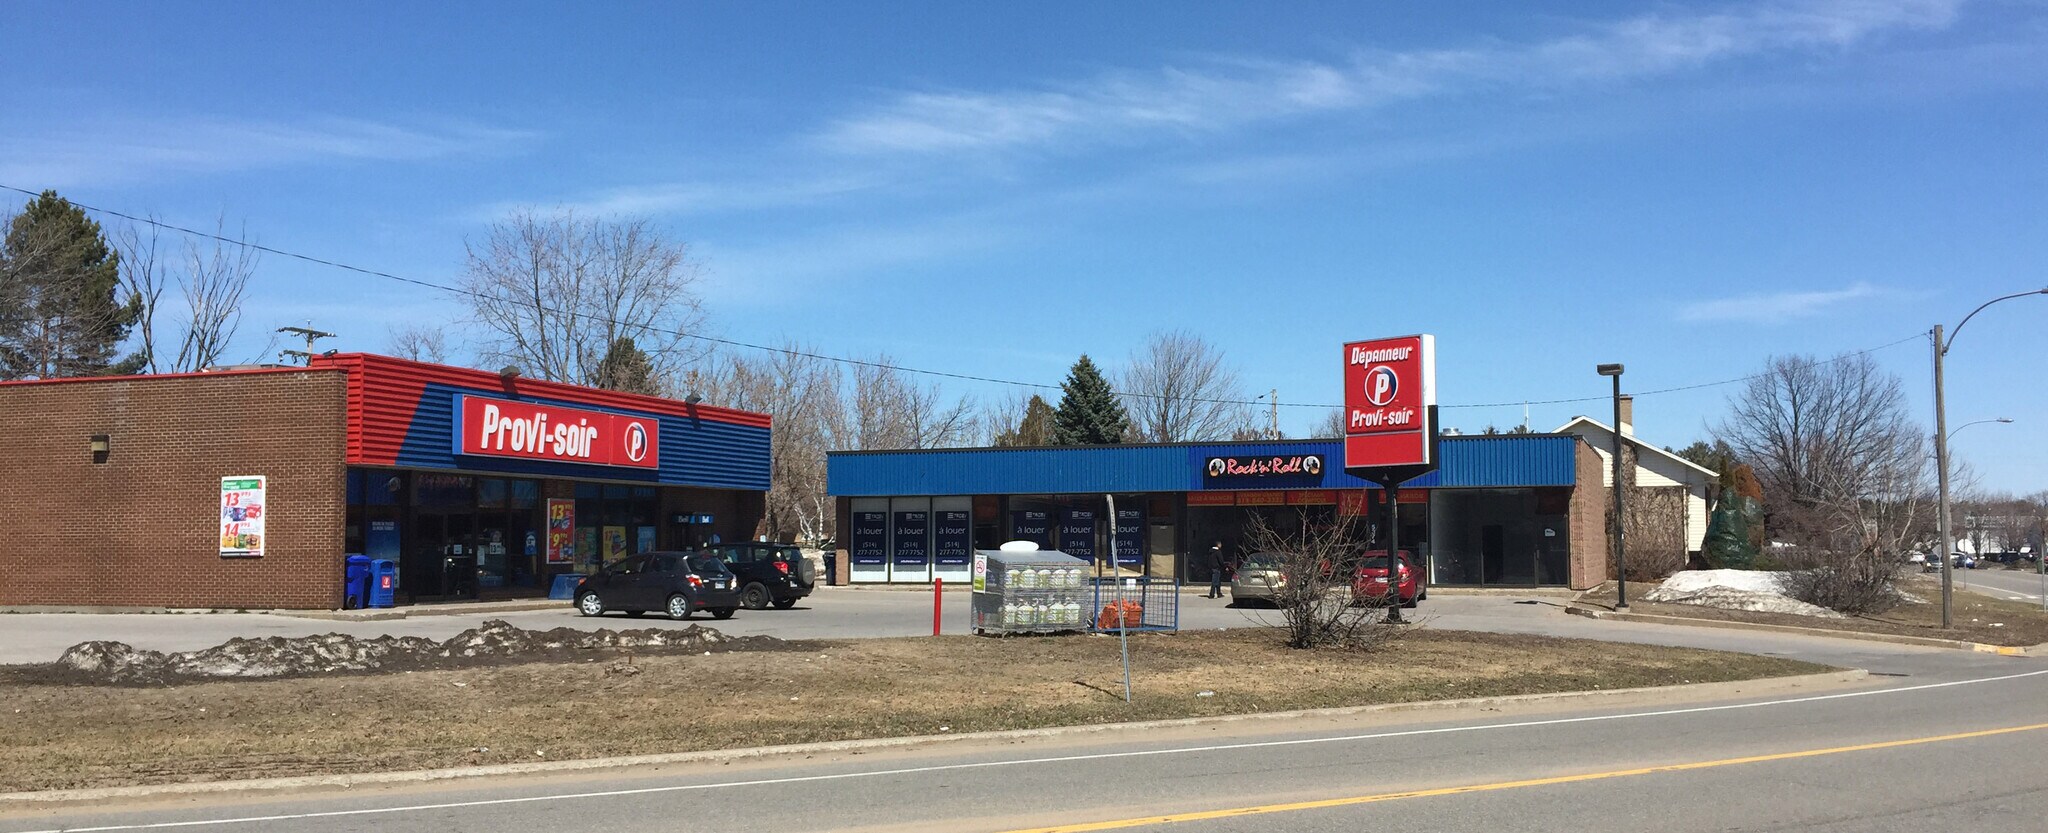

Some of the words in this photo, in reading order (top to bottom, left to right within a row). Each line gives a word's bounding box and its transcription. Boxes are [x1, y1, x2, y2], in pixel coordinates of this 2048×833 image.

[1351, 346, 1413, 369] Dépanneur
[1374, 373, 1390, 404] P
[1351, 407, 1414, 428] Provi-soir
[481, 404, 598, 458] Provi-soir
[631, 430, 642, 460] P
[224, 492, 240, 507] 13
[551, 504, 564, 520] 13
[224, 523, 240, 537] 14
[856, 527, 862, 535] à
[863, 527, 883, 535] louer
[897, 527, 903, 535] à
[904, 527, 924, 535] louer
[938, 526, 944, 534] à
[945, 526, 966, 534] louer
[1017, 526, 1023, 534] à
[1024, 526, 1045, 534] louer
[1063, 525, 1069, 534] à
[1070, 525, 1091, 534] louer
[1117, 525, 1140, 533] louer
[862, 541, 877, 549] (514)
[903, 541, 918, 549] (514)
[1069, 540, 1086, 548] (514)
